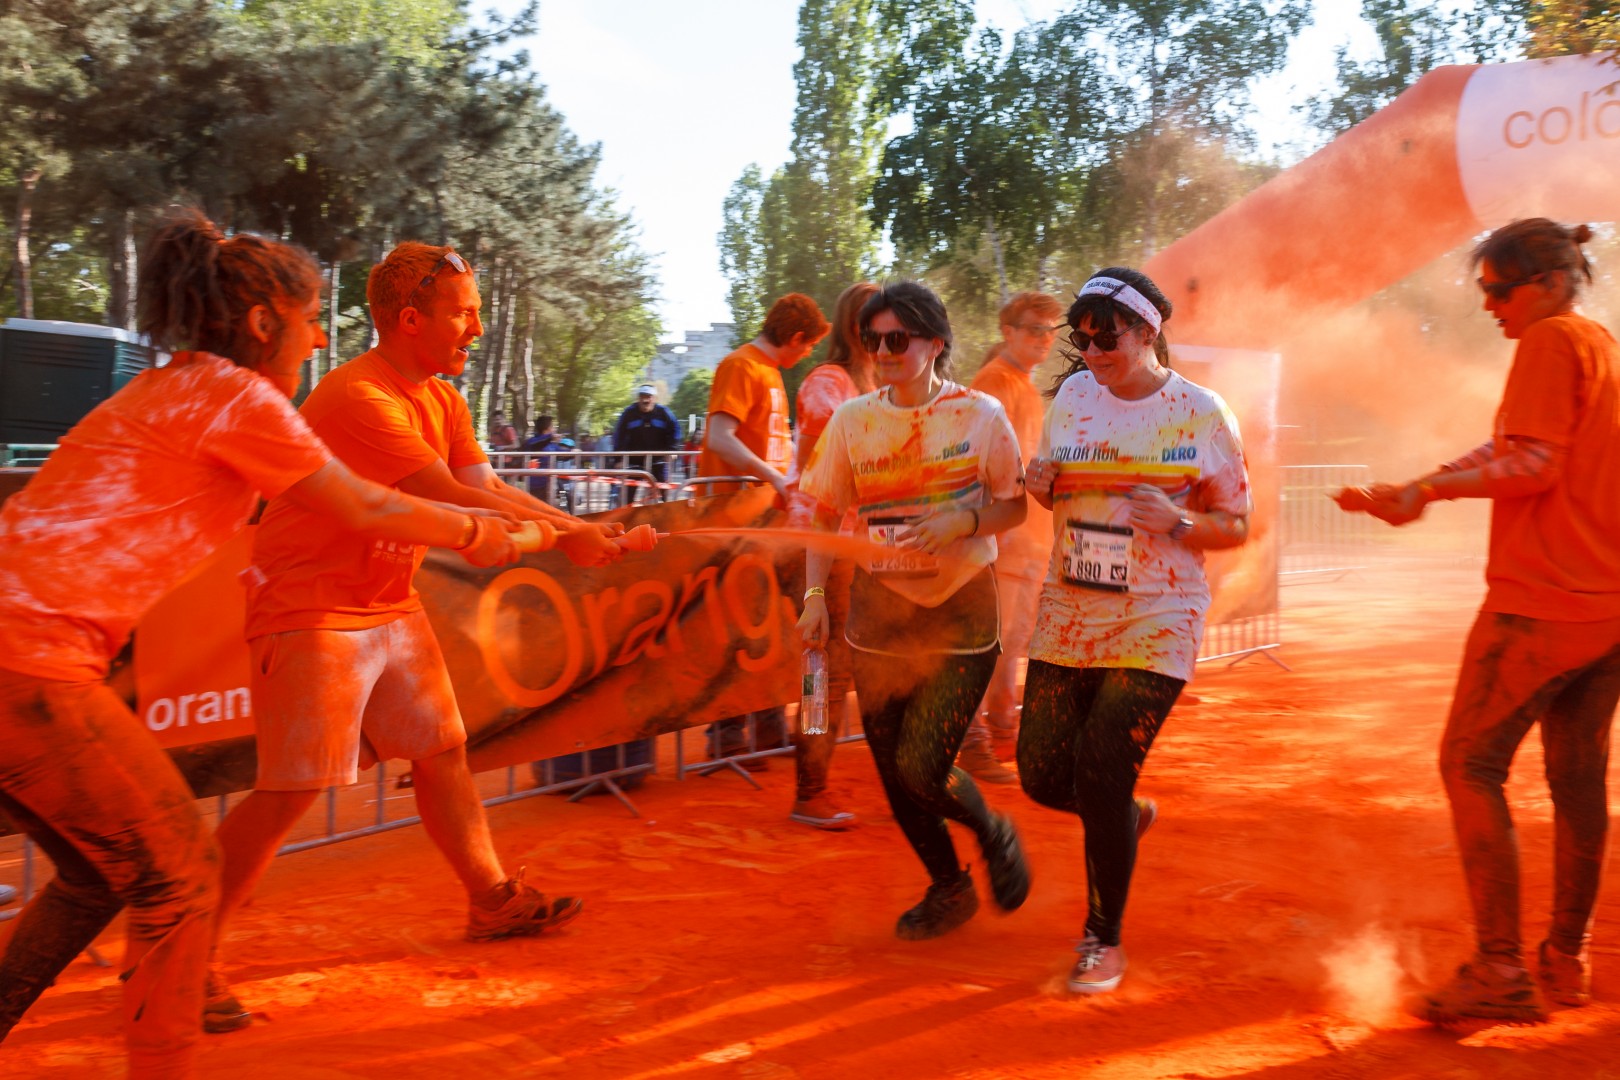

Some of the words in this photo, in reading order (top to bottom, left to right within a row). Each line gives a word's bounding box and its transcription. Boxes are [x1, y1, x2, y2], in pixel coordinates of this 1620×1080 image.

[860, 457, 889, 475] COLOR
[943, 440, 970, 460] DERO
[1055, 446, 1089, 462] COLOR
[1092, 446, 1119, 462] RUN
[1162, 446, 1197, 462] DERO
[1077, 559, 1102, 582] 890
